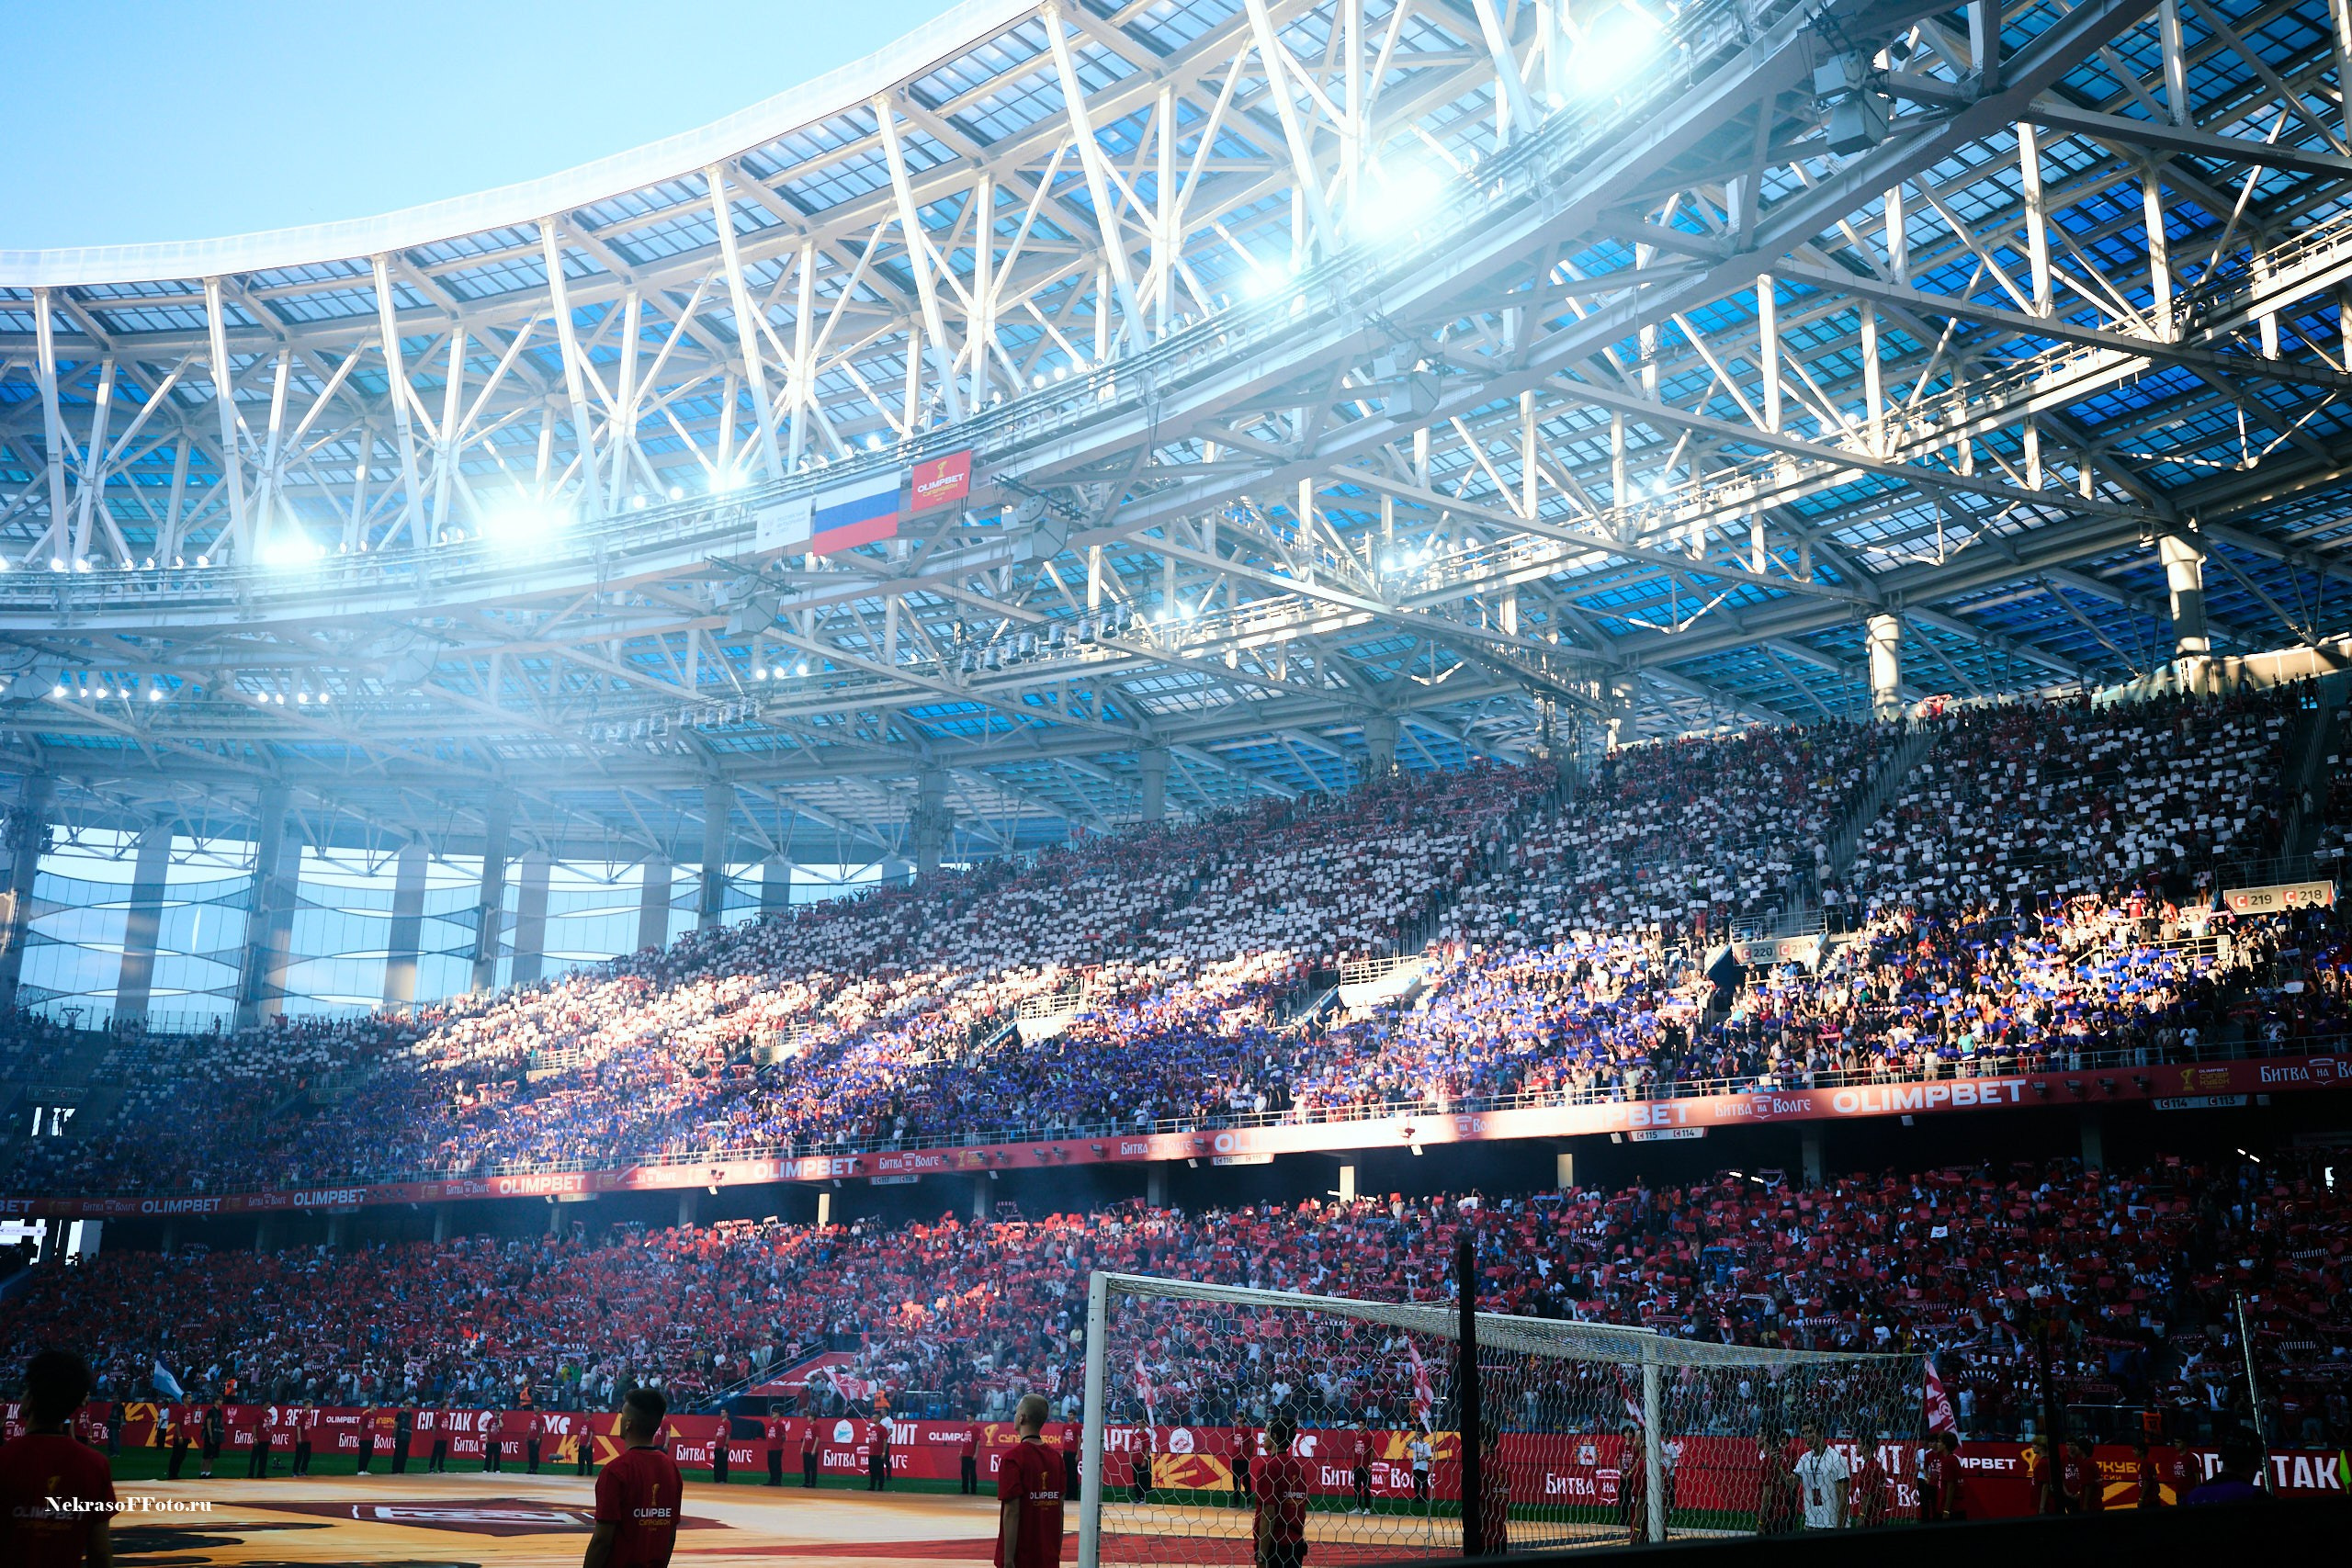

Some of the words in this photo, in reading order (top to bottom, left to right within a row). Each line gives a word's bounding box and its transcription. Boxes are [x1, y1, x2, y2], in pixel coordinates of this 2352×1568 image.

[917, 472, 965, 493] OLIMPBET
[2251, 894, 2272, 906] 219
[2300, 889, 2323, 901] 218
[1753, 947, 1773, 958] 220
[1832, 1079, 2027, 1113] OLIMPBET
[2220, 1096, 2235, 1105] 113
[2171, 1099, 2188, 1107] 114
[1645, 1131, 1657, 1139] 115
[1681, 1129, 1695, 1137] 114
[1222, 1156, 1233, 1164] 116
[753, 1157, 857, 1179] OLIMPBET
[499, 1174, 585, 1194] OLIMPBET
[293, 1188, 368, 1206] OLIMPBET
[141, 1198, 221, 1213] OLIMPBET
[285, 1408, 321, 1427] ЗЕТ
[326, 1416, 361, 1424] OLIMPBET
[417, 1411, 473, 1431] СПТАК
[272, 1433, 289, 1445] ОЛГЕ
[928, 1431, 962, 1441] OLIMP
[728, 1449, 752, 1463] ОЛГЕ
[1960, 1457, 2017, 1470] MPBET
[1321, 1465, 1355, 1486] БИТВ
